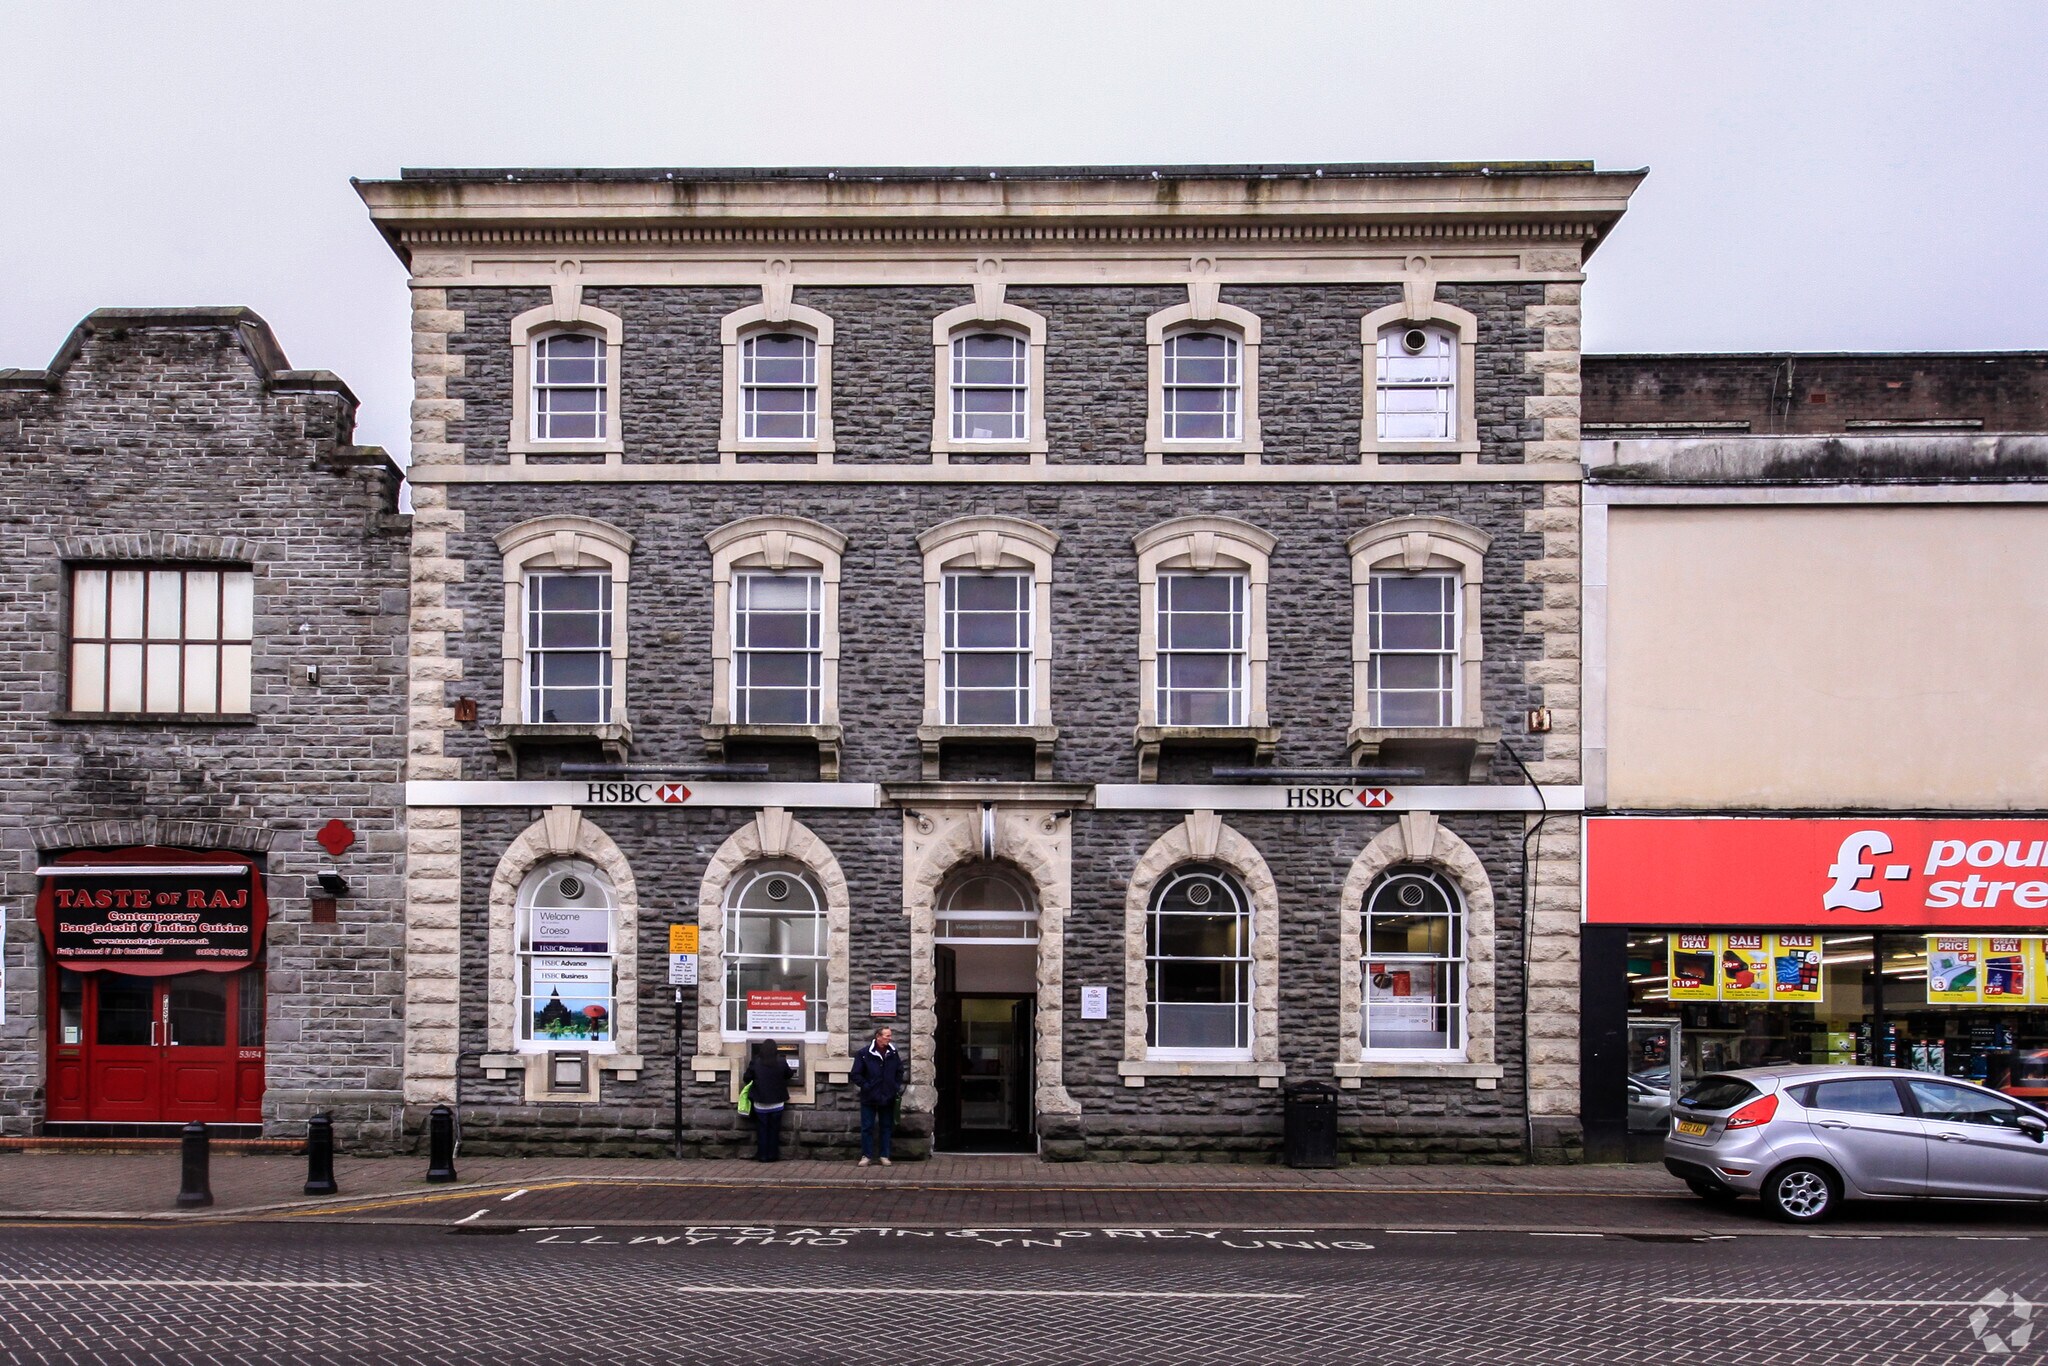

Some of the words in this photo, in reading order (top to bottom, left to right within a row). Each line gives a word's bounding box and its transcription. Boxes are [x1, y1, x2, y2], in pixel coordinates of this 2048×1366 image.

[586, 783, 652, 803] HSBC
[1286, 788, 1353, 808] HSBC
[55, 889, 151, 909] TASTE
[187, 889, 248, 909] RAJ
[108, 911, 200, 923] Contemporary
[540, 912, 580, 920] Welcome
[60, 922, 138, 935] Bangladeshi
[140, 922, 151, 933] &
[154, 922, 197, 933] Indian
[199, 922, 248, 933] Cuisine
[540, 926, 570, 935] Croeso
[1730, 935, 1760, 946] SALE
[1781, 936, 1812, 946] SALE
[1938, 942, 1968, 950] PRICE
[239, 1050, 262, 1058] 53/54
[685, 1226, 979, 1238] LOADING
[1056, 1229, 1222, 1239] ONLY
[535, 1235, 849, 1246] LLWYTHO
[976, 1238, 1063, 1248] YN
[1221, 1240, 1376, 1250] UNIG
